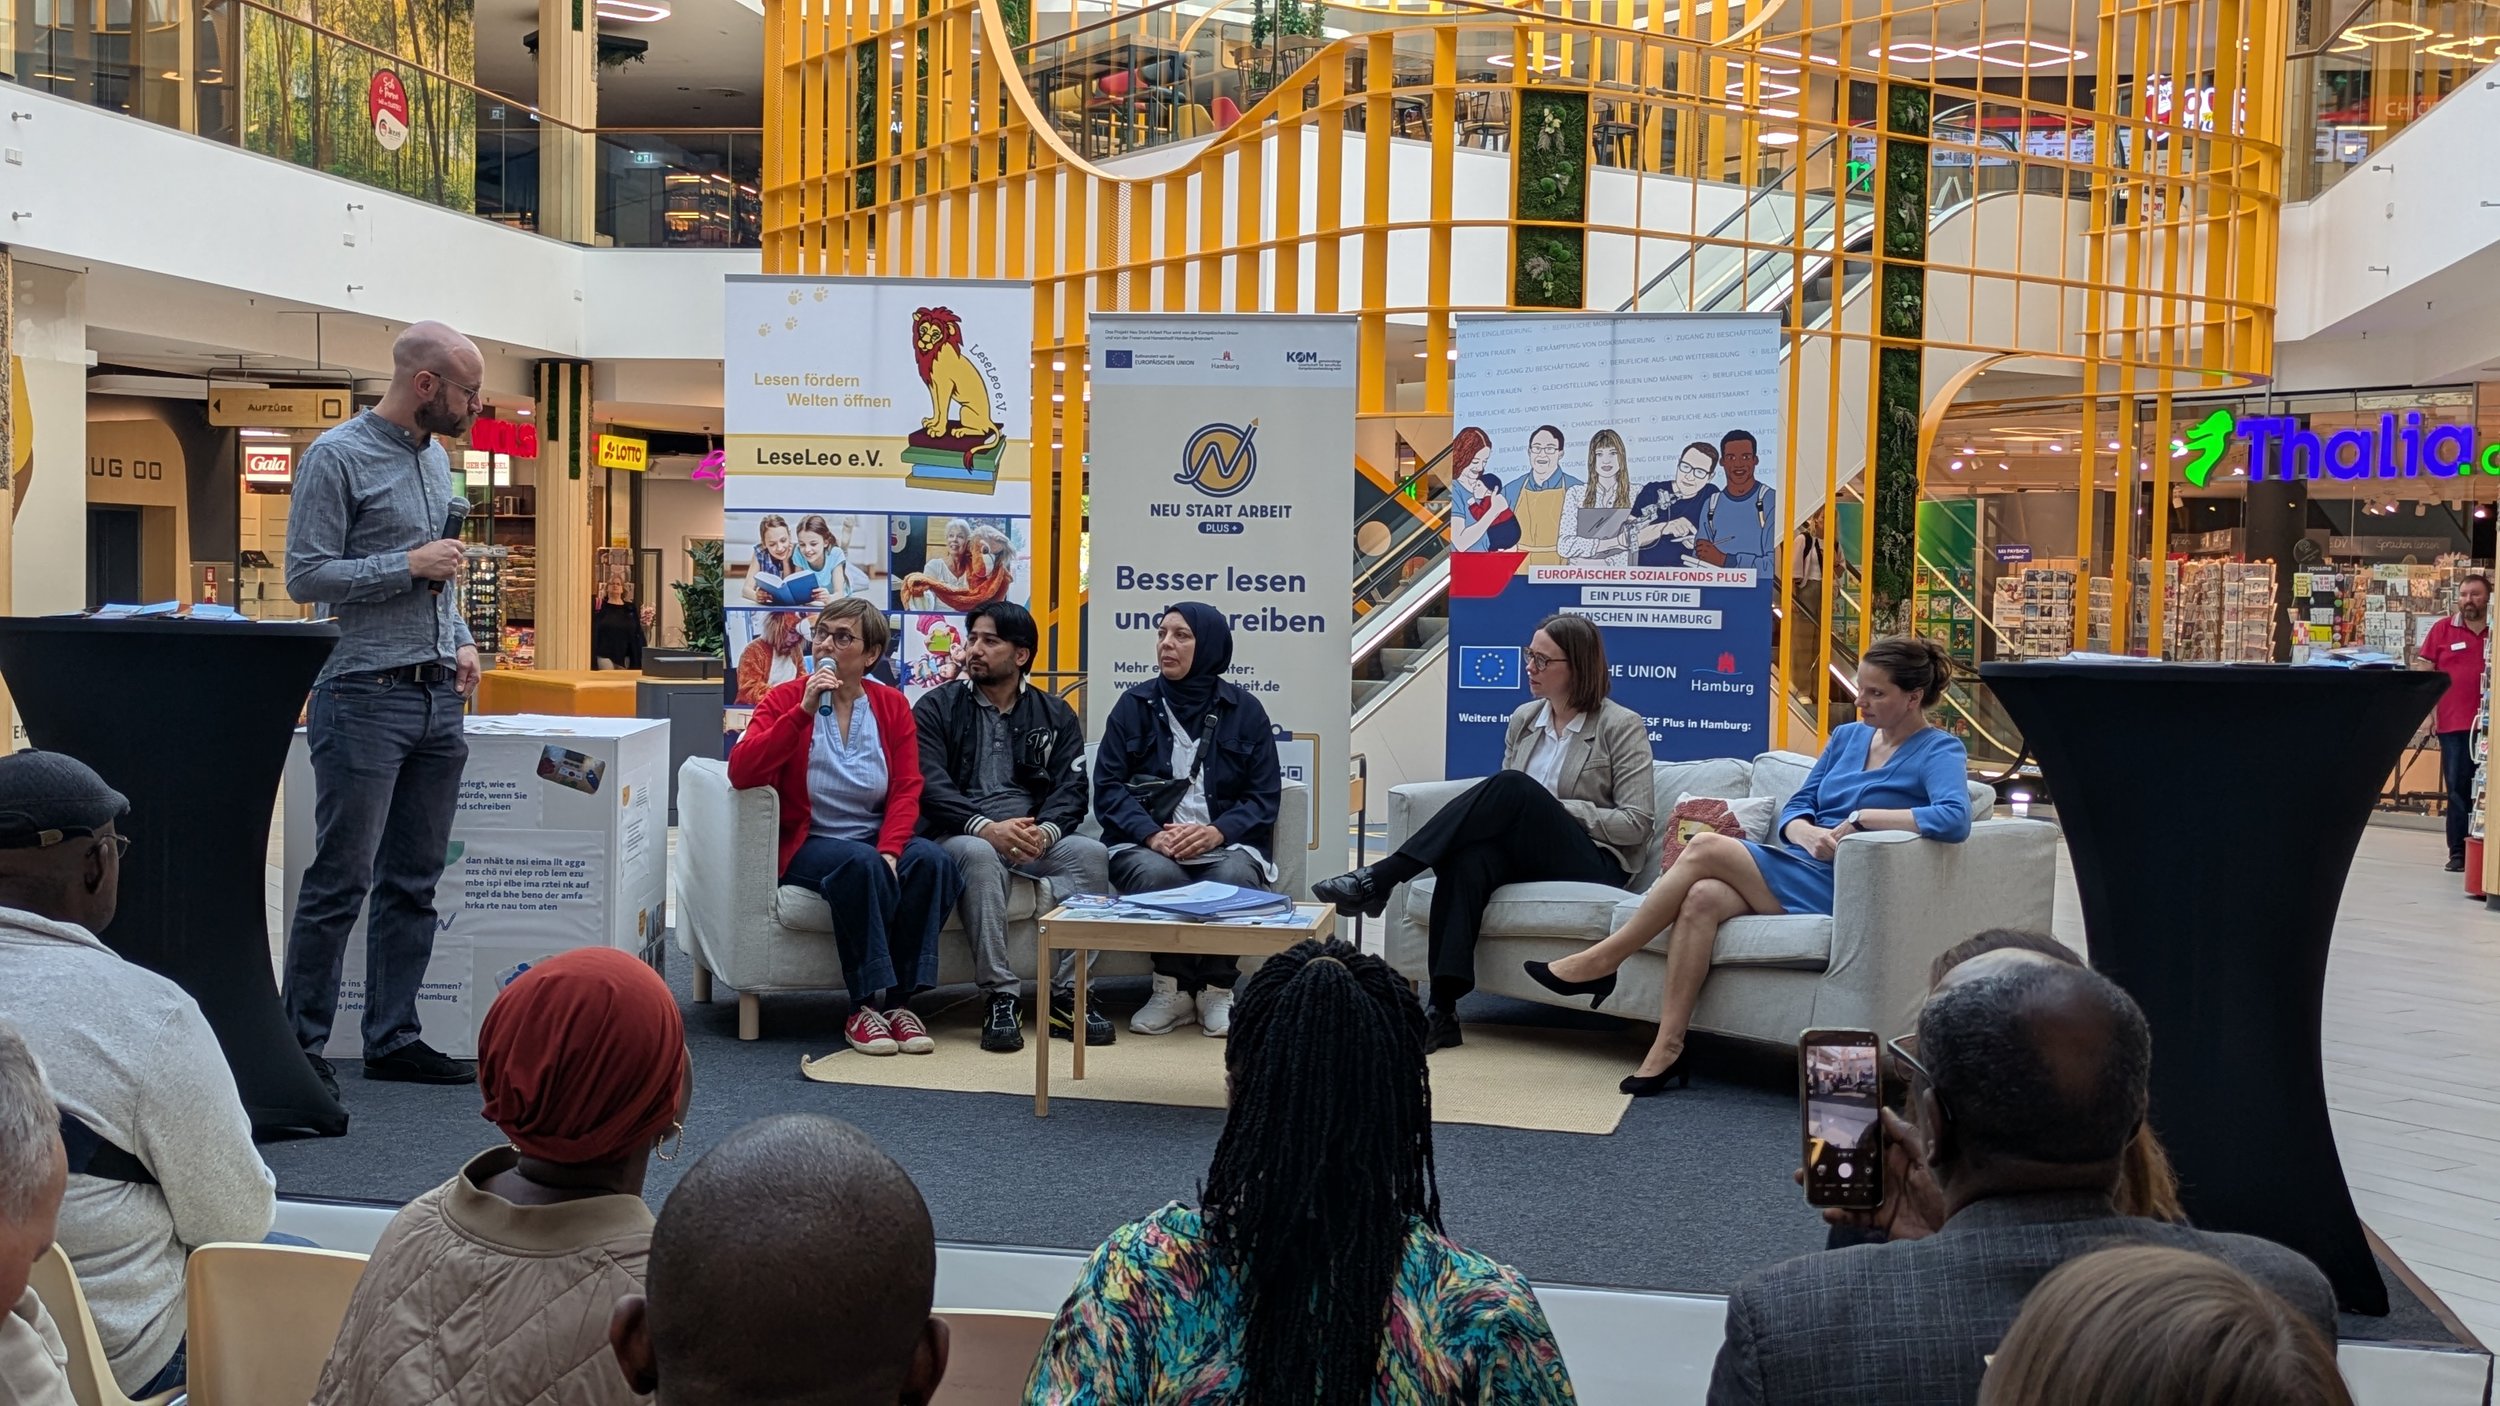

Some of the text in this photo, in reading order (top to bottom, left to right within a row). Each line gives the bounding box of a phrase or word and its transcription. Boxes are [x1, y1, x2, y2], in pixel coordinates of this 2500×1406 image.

[1676, 334, 1704, 342] ZUGANG
[1716, 328, 1774, 338] BESCHÄFTIGUNG
[1582, 340, 1596, 348] VON
[1490, 348, 1516, 356] FRAUEN
[1610, 356, 1650, 366] BERUFLICHE
[1668, 354, 1684, 362] UND
[1685, 350, 1740, 360] WEITERBILDUNG
[1496, 368, 1524, 376] ZUGANG
[1535, 362, 1590, 372] BESCHÄFTIGUNG
[1712, 370, 1752, 379] BERUFLICHE
[754, 373, 859, 387] Lesen fördern
[969, 344, 1007, 415] LeseLeo e.V.
[1542, 373, 1692, 392] GLEICHSTELLUNG VON FRAUEN UND MÄNNERN
[1496, 386, 1522, 395] FRAUEN
[1636, 394, 1674, 404] MENSCHEN
[1682, 393, 1698, 401] DEN
[1699, 390, 1750, 400] ARBEITSMARKT
[787, 393, 891, 408] Welten öffnen
[1468, 408, 1506, 418] BERUFLICHE
[1540, 401, 1593, 412] WEITERBILDUNG
[1661, 413, 1701, 422] BERUFLICHE
[1720, 410, 1736, 418] UND
[1571, 417, 1640, 428] CHANCENGLEICHHEIT
[1638, 434, 1674, 443] INKLUSION
[615, 446, 642, 463] LOTTO
[757, 448, 883, 467] LeseLeo e.V.
[250, 456, 286, 472] Gala
[1150, 503, 1292, 518] NEU START ARBEIT
[1206, 523, 1229, 533] PLUS
[1116, 565, 1306, 593] Besser lesen
[1536, 567, 1747, 583] EUROPÄISCHER SOZIALFONDS PLUS
[1590, 590, 1692, 603] EIN PLUS FÜR DIE
[1228, 607, 1325, 633] reiben
[1636, 613, 1648, 623] IN
[1651, 613, 1713, 625] HAMBURG
[1114, 662, 1148, 673] Mehr
[1628, 665, 1677, 679] UNION
[1691, 679, 1754, 695] Hamburg
[1458, 713, 1498, 723] Weitere
[1662, 717, 1685, 728] Plus
[1687, 719, 1698, 728] in
[1700, 719, 1752, 732] Hamburg:
[514, 792, 527, 800] Sie
[469, 803, 511, 811] schreiben
[465, 857, 481, 865] dan
[484, 857, 503, 865] nhät
[530, 858, 551, 866] eima
[565, 859, 586, 868] agga
[481, 868, 497, 876] chö
[500, 868, 512, 876] nvi
[514, 869, 532, 878] elep
[535, 869, 549, 877] rob
[551, 869, 567, 877] lem
[465, 879, 484, 887] mbe
[487, 879, 501, 889] ispi
[524, 880, 540, 888] ima
[542, 880, 561, 888] rztei
[575, 881, 590, 889] auf
[465, 890, 489, 899] engel
[504, 891, 520, 899] bhe
[522, 891, 543, 899] beno
[545, 891, 559, 900] der
[561, 892, 583, 900] amfa
[539, 903, 558, 911] aten
[418, 993, 458, 1002] Hamburg
